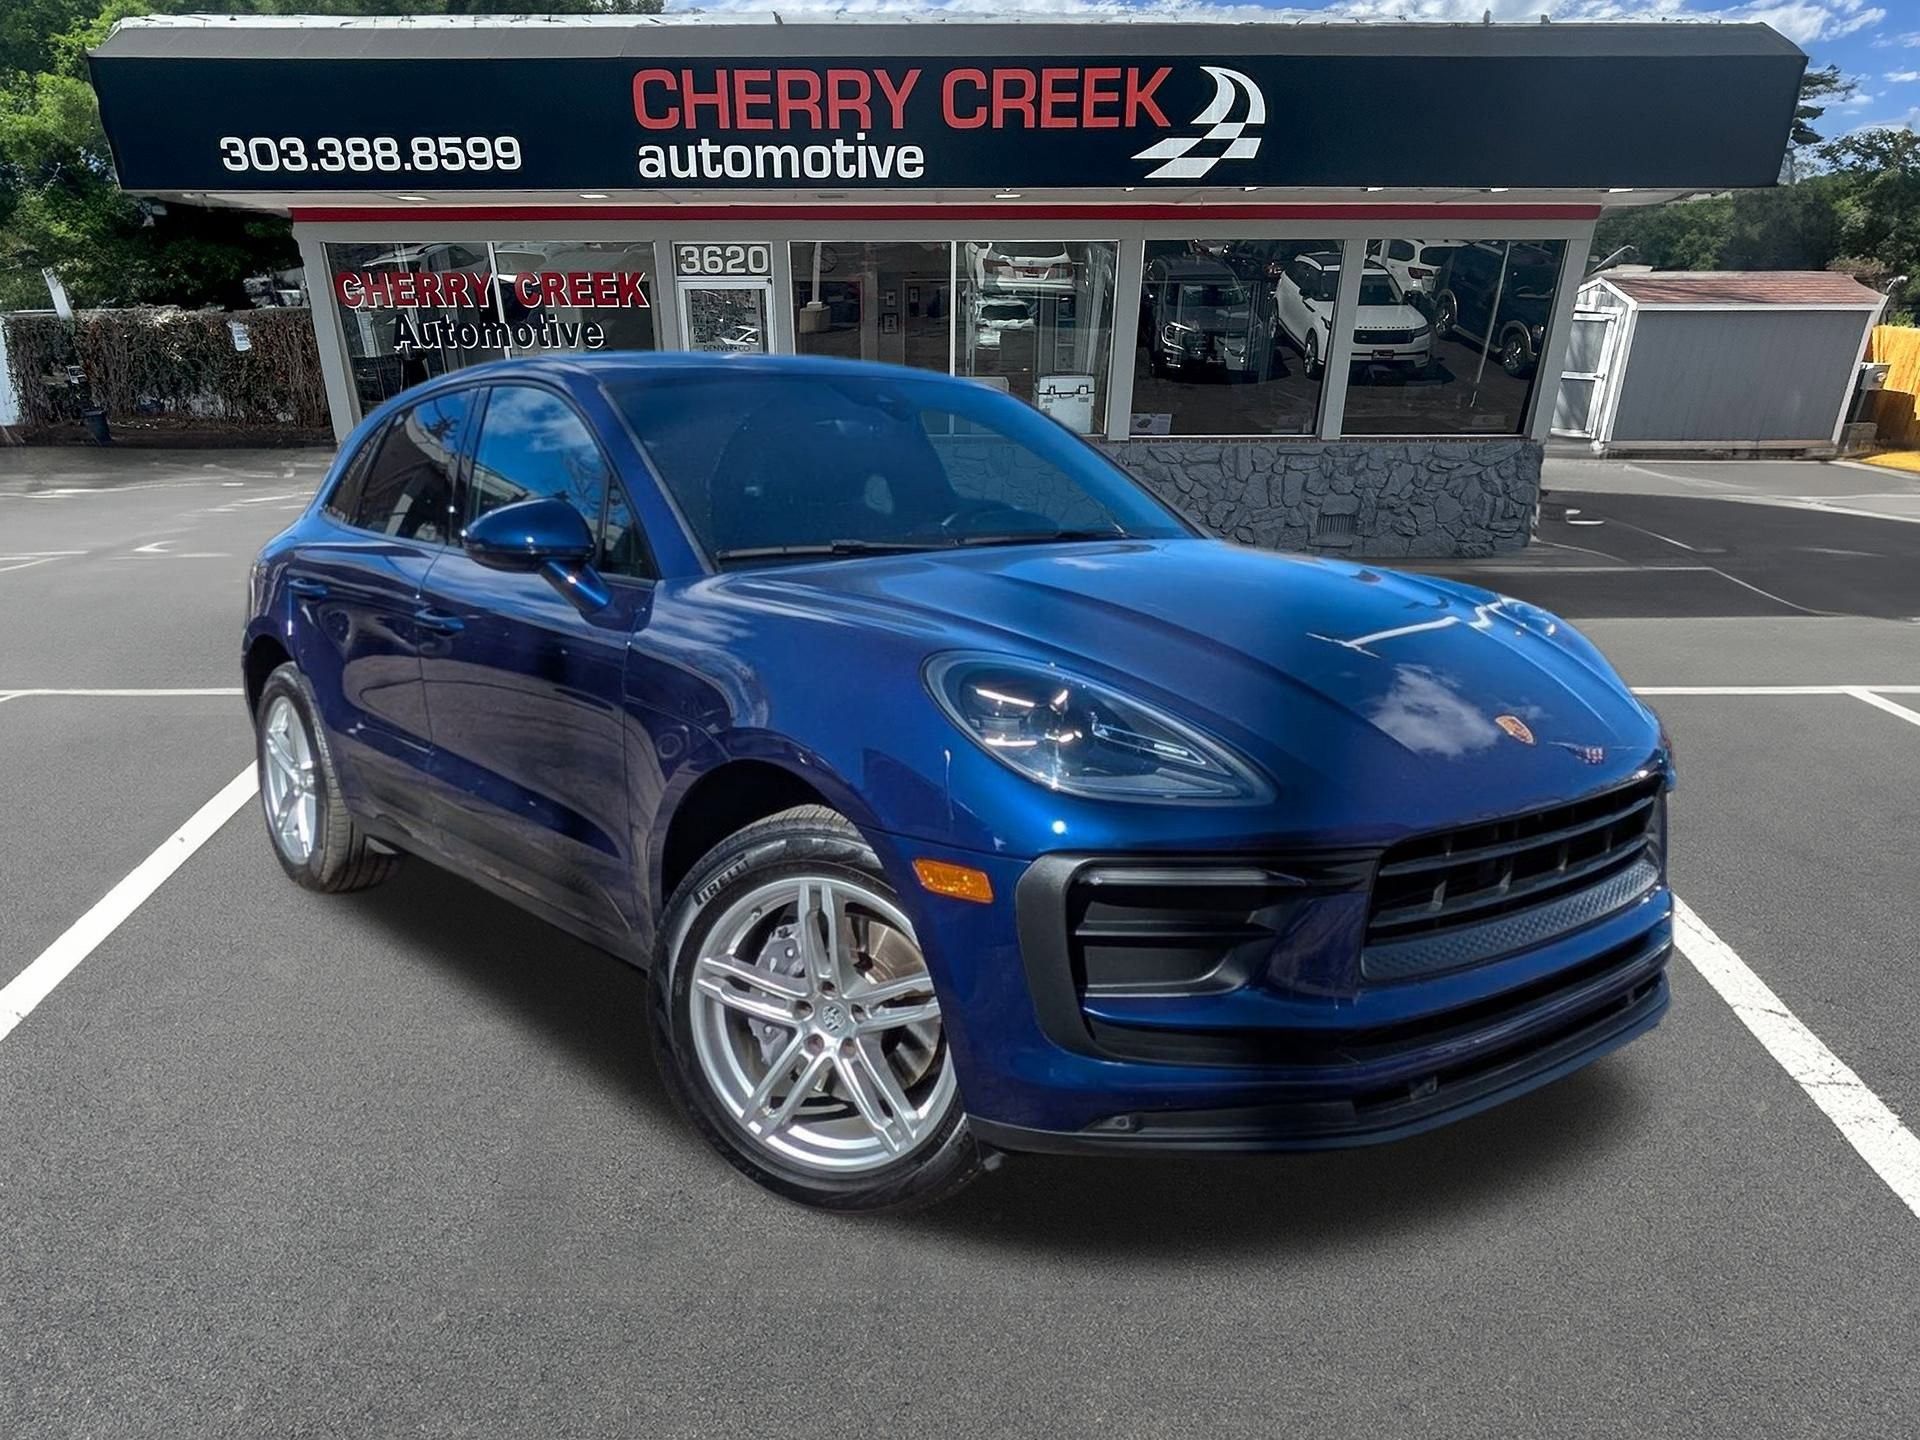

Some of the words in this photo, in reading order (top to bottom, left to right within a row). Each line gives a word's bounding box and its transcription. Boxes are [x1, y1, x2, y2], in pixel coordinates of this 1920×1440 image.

[632, 67, 921, 130] CHERRY
[942, 67, 1171, 129] CREEK
[220, 136, 522, 172] 303.388.8599
[638, 132, 924, 179] automotive
[680, 245, 769, 274] 3620
[335, 271, 492, 308] CHERRY
[514, 271, 650, 308] CREEK
[393, 313, 606, 349] Automotive
[693, 854, 750, 906] PIRELLI
